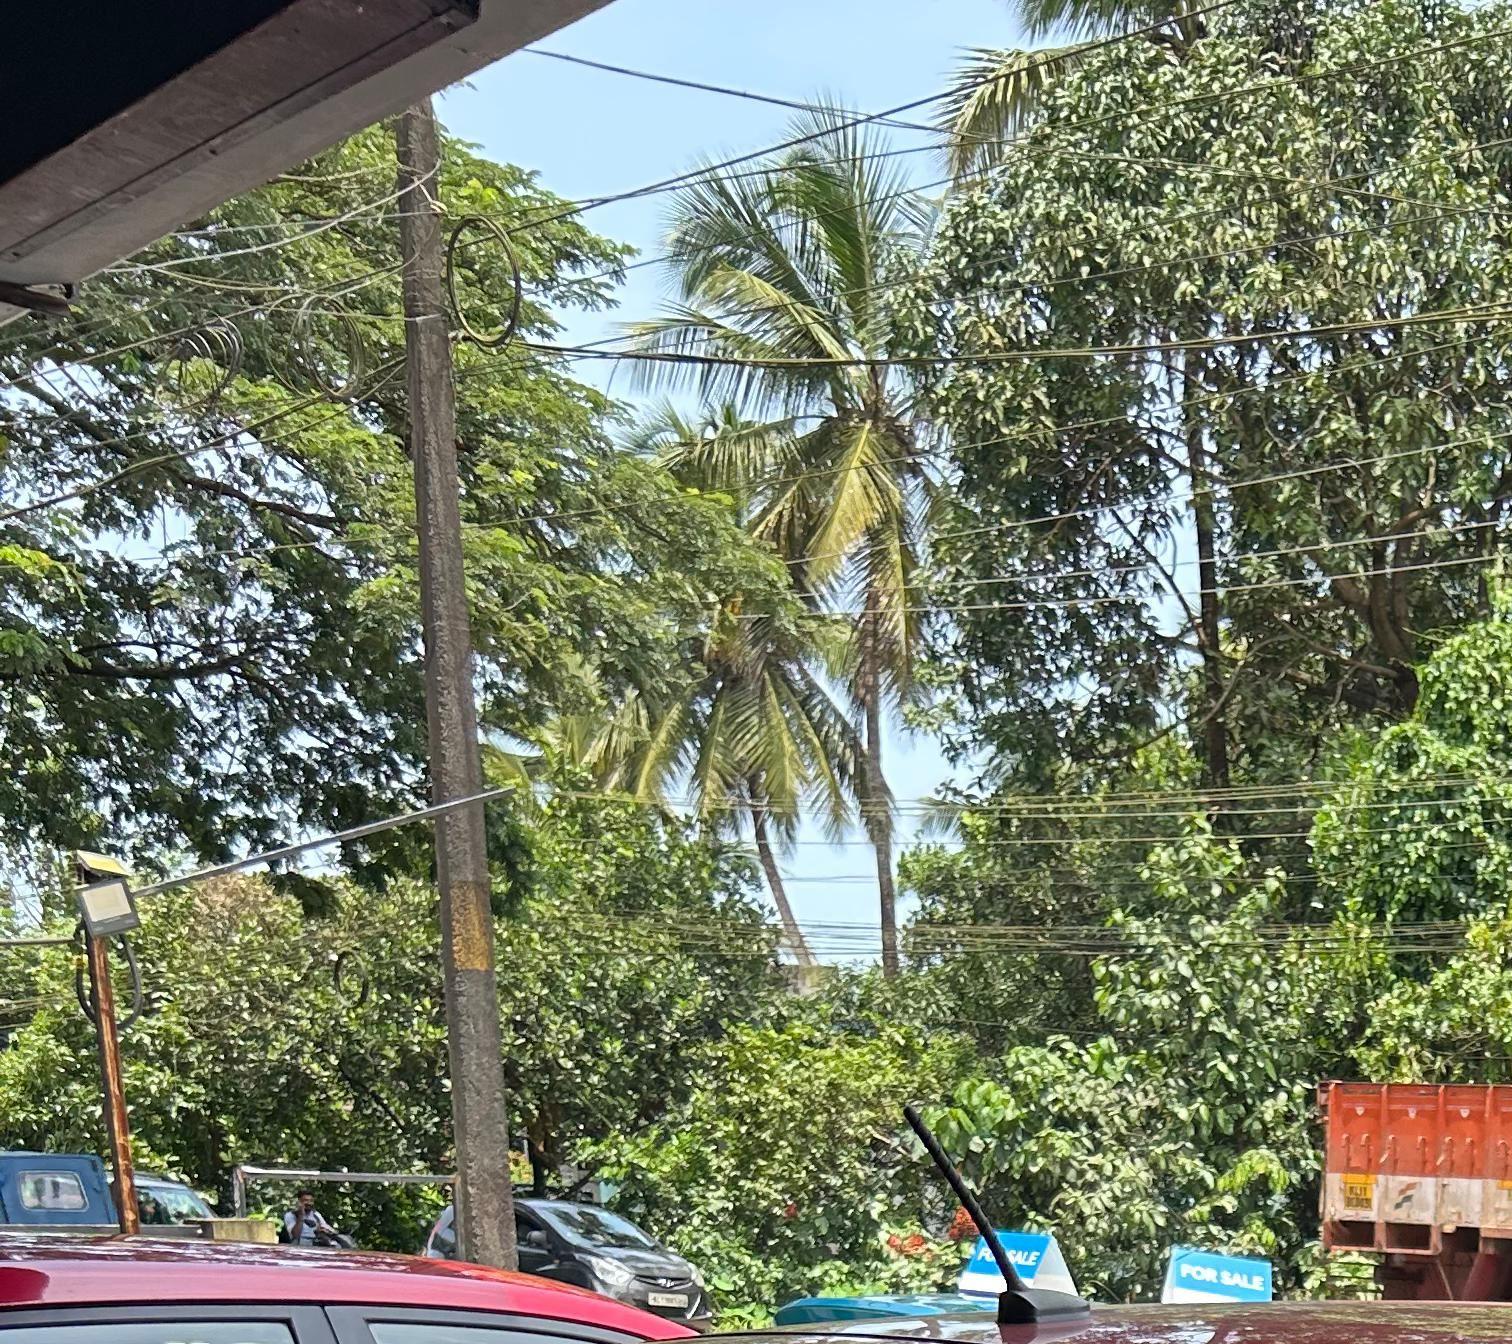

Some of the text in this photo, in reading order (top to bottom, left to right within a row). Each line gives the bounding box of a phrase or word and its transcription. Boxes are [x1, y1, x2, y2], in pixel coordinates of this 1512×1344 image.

[1008, 1250, 1041, 1266] SALE
[1180, 1263, 1265, 1291] FOR SALE
